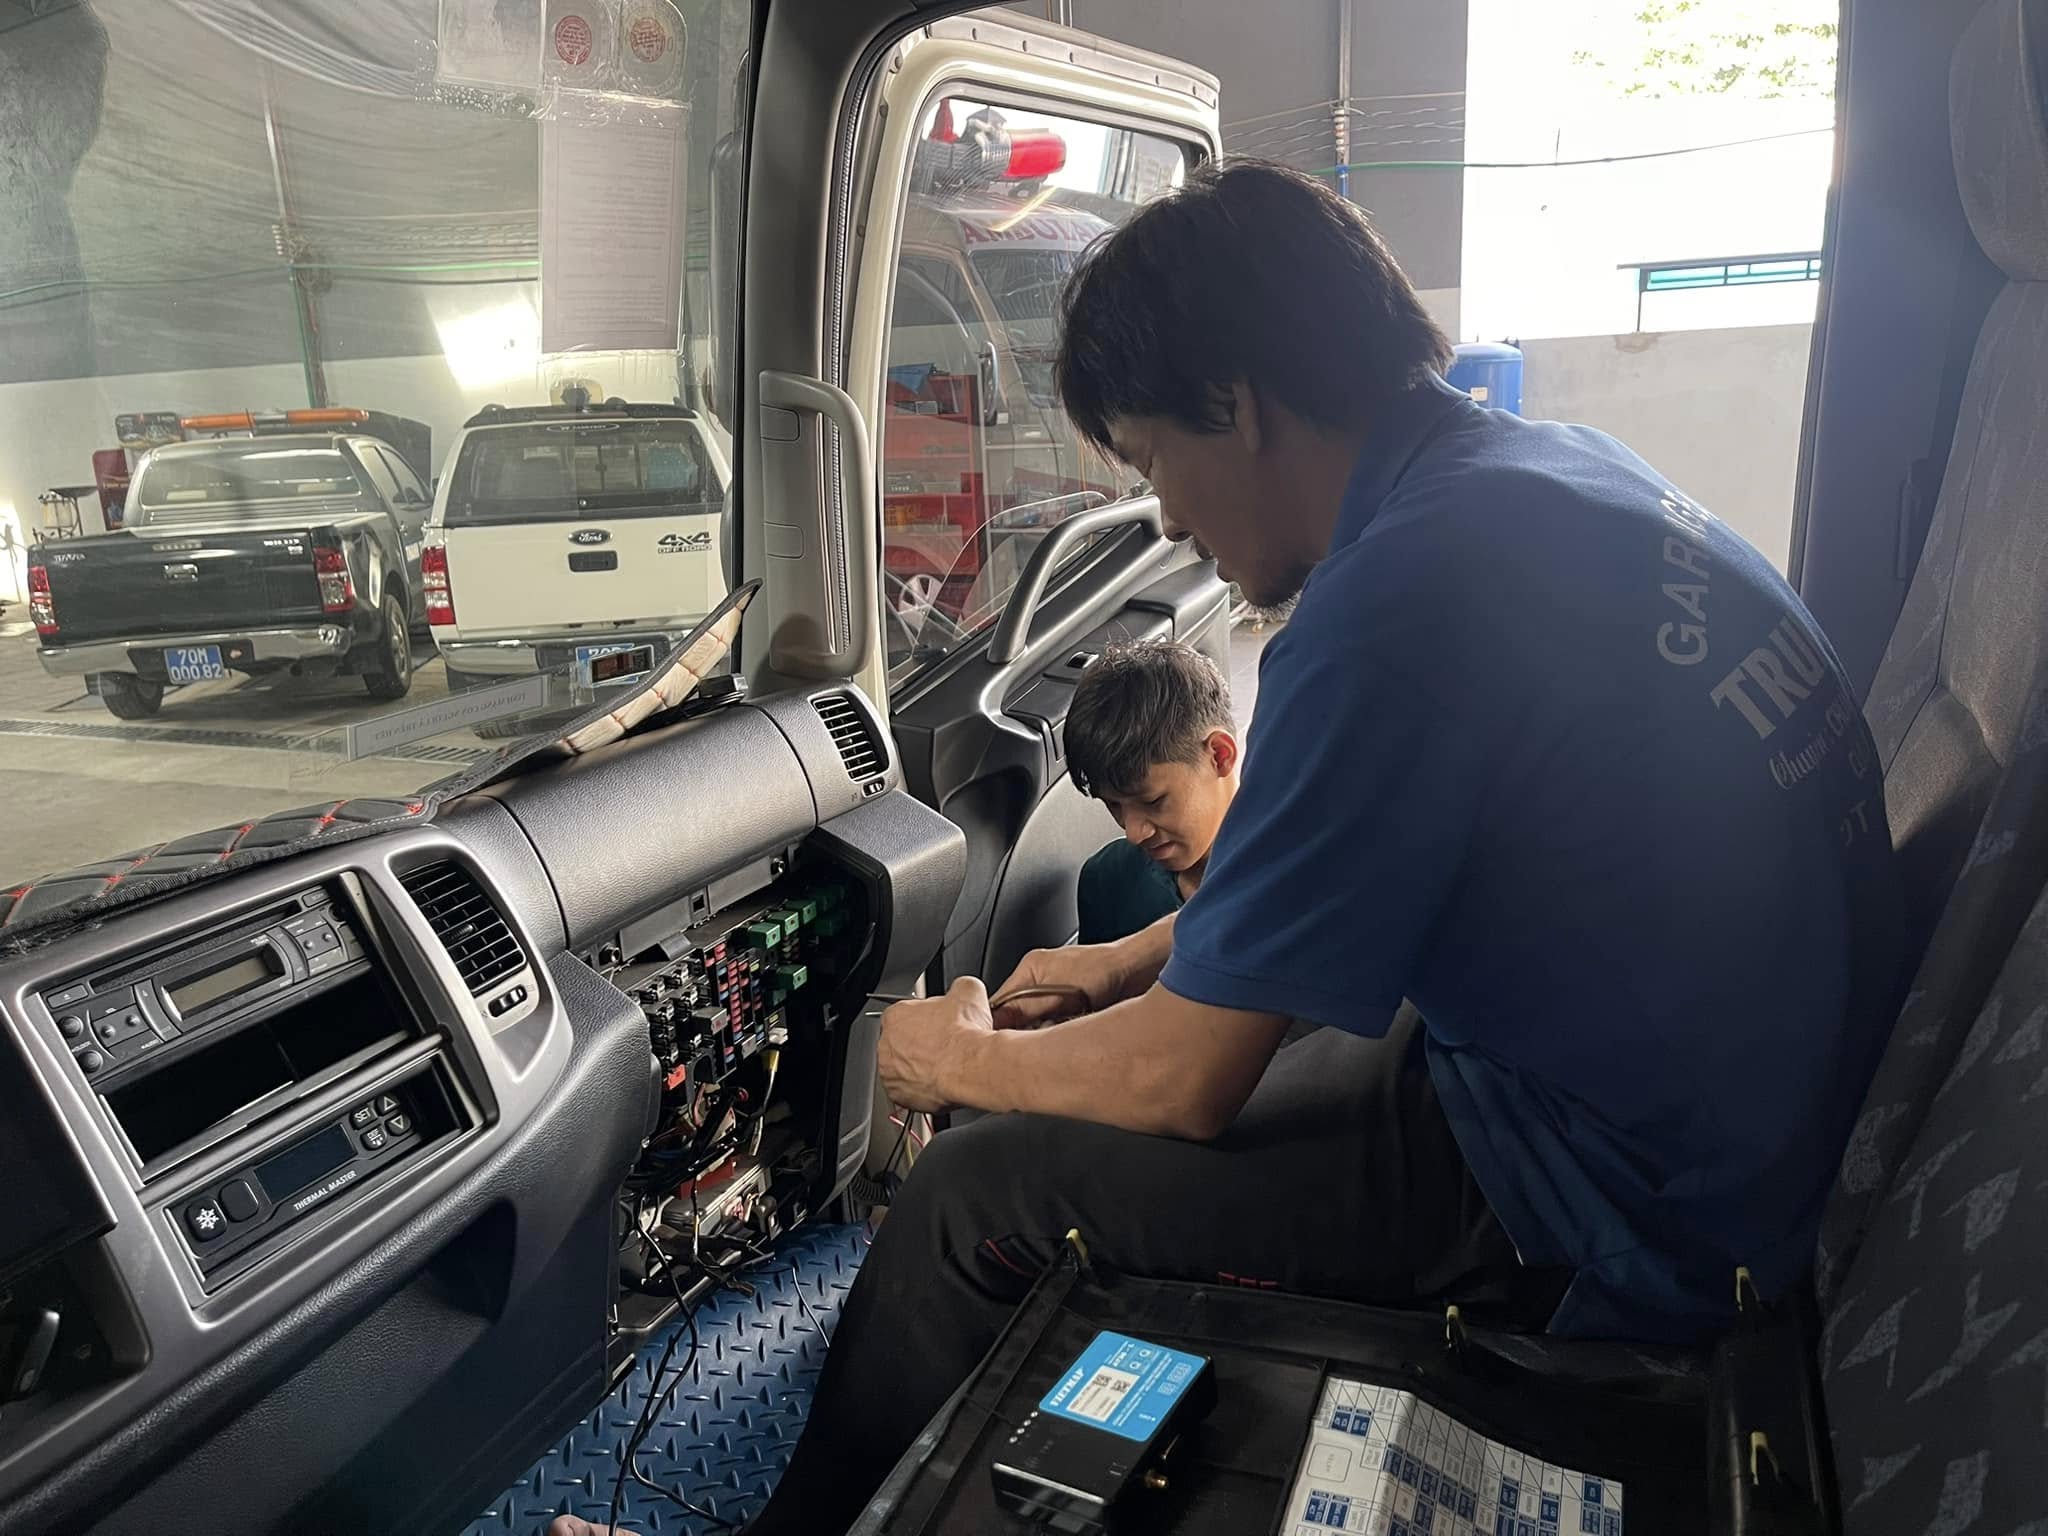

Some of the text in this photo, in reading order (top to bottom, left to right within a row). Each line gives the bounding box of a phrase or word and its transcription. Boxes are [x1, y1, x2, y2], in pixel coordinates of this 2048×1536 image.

[354, 1107, 372, 1123] SET
[293, 1170, 357, 1211] THERMAL MASTER
